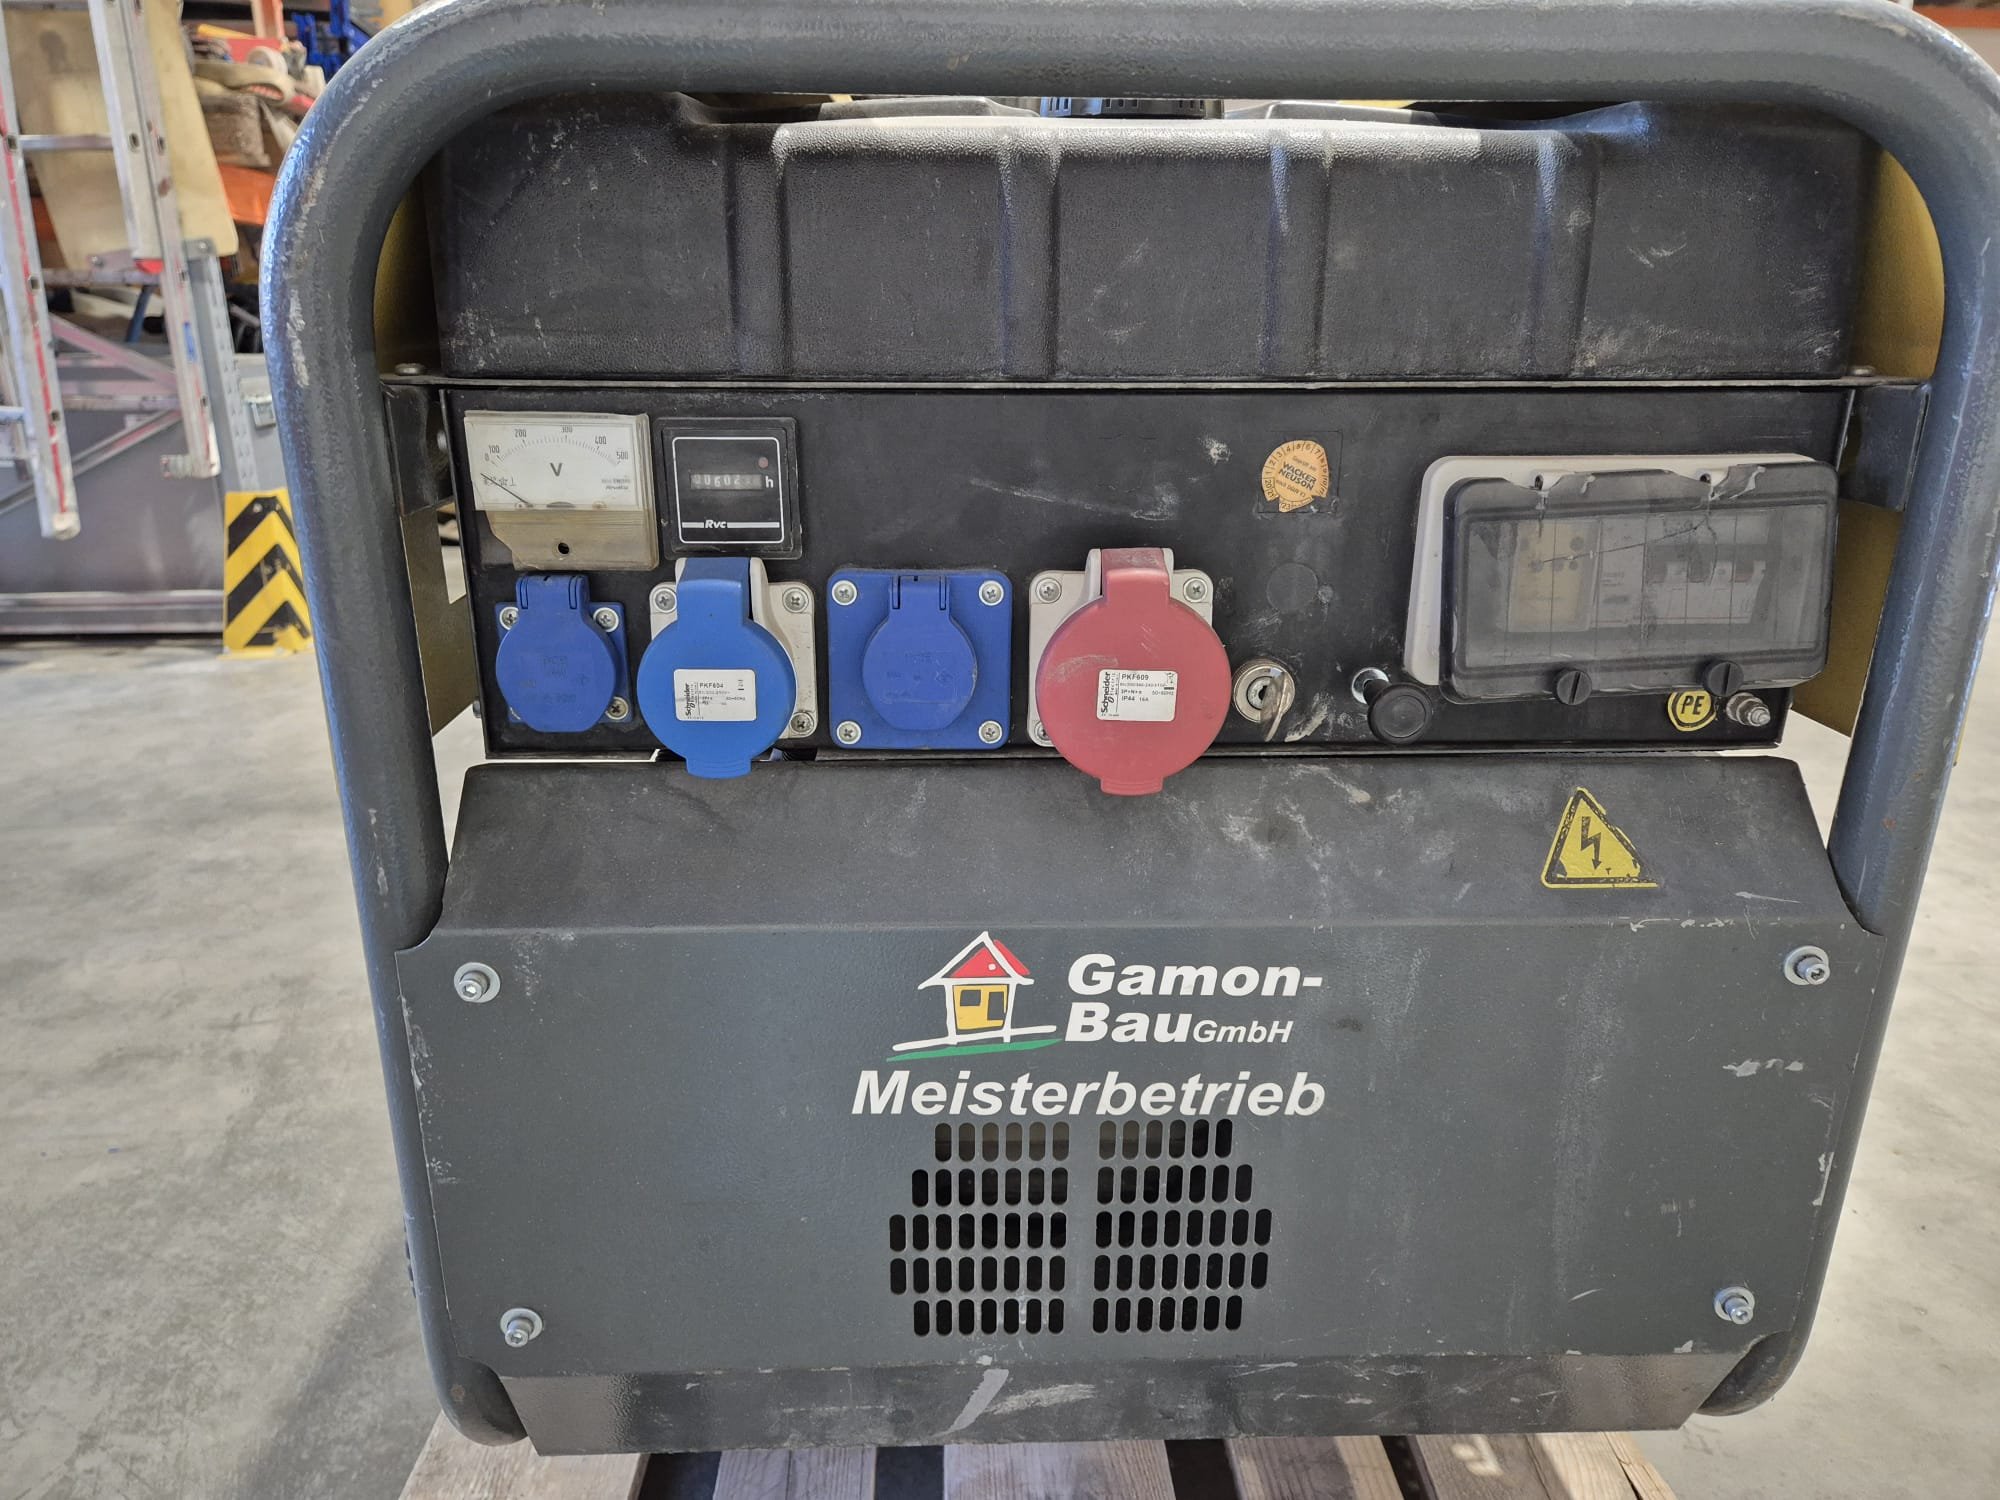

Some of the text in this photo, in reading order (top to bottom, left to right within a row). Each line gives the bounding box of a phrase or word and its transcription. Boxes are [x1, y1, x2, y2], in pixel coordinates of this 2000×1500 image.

[514, 428, 527, 438] 200
[561, 425, 573, 433] 300
[594, 436, 607, 445] 400
[488, 444, 500, 453] 100
[616, 451, 629, 460] 500
[549, 462, 563, 477] V
[1283, 461, 1317, 484] WACKER
[765, 475, 774, 489] h
[1265, 479, 1272, 488] 20
[1278, 468, 1314, 491] NEUSON
[704, 519, 727, 529] Rvc
[1100, 672, 1111, 713] Schneider
[1680, 695, 1705, 715] PE
[1067, 953, 1322, 997] Gamon-
[851, 1070, 1325, 1116] Meisterbetrieb
